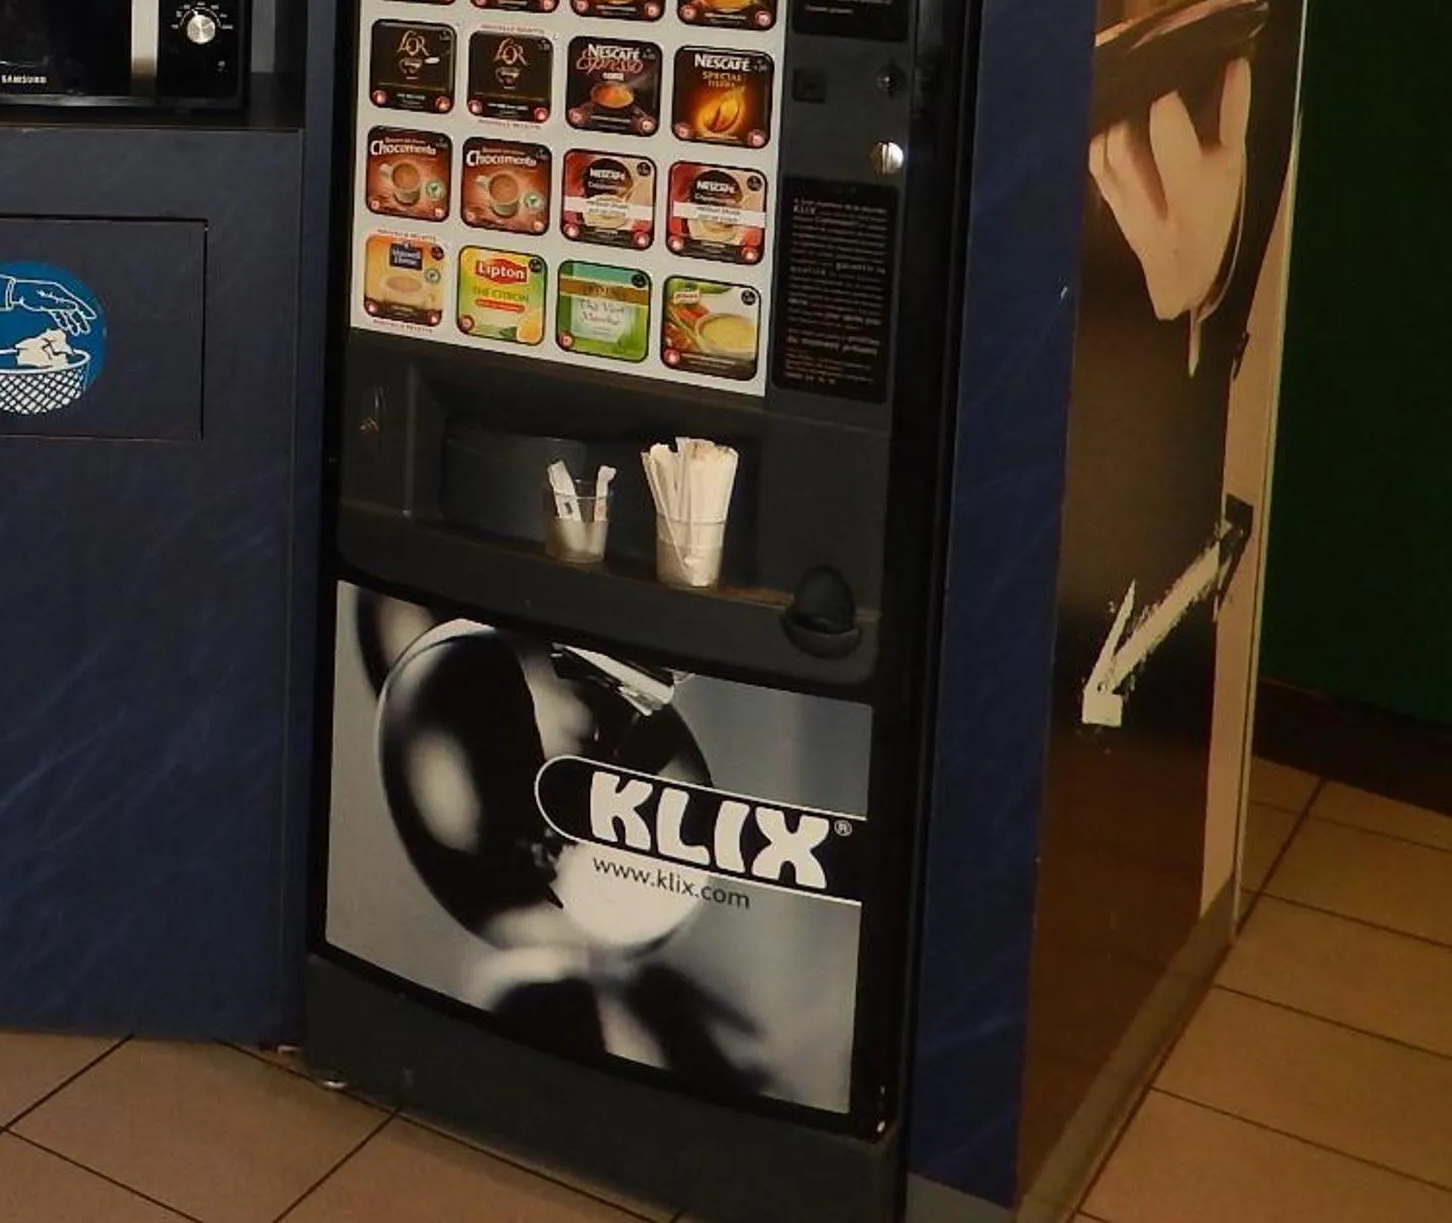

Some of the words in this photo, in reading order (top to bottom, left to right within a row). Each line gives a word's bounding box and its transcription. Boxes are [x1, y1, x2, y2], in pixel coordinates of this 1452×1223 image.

[1, 74, 47, 84] SAMSUNG
[477, 261, 526, 280] Lipton
[590, 771, 830, 889] KLIX
[592, 855, 750, 910] www.klix.com
